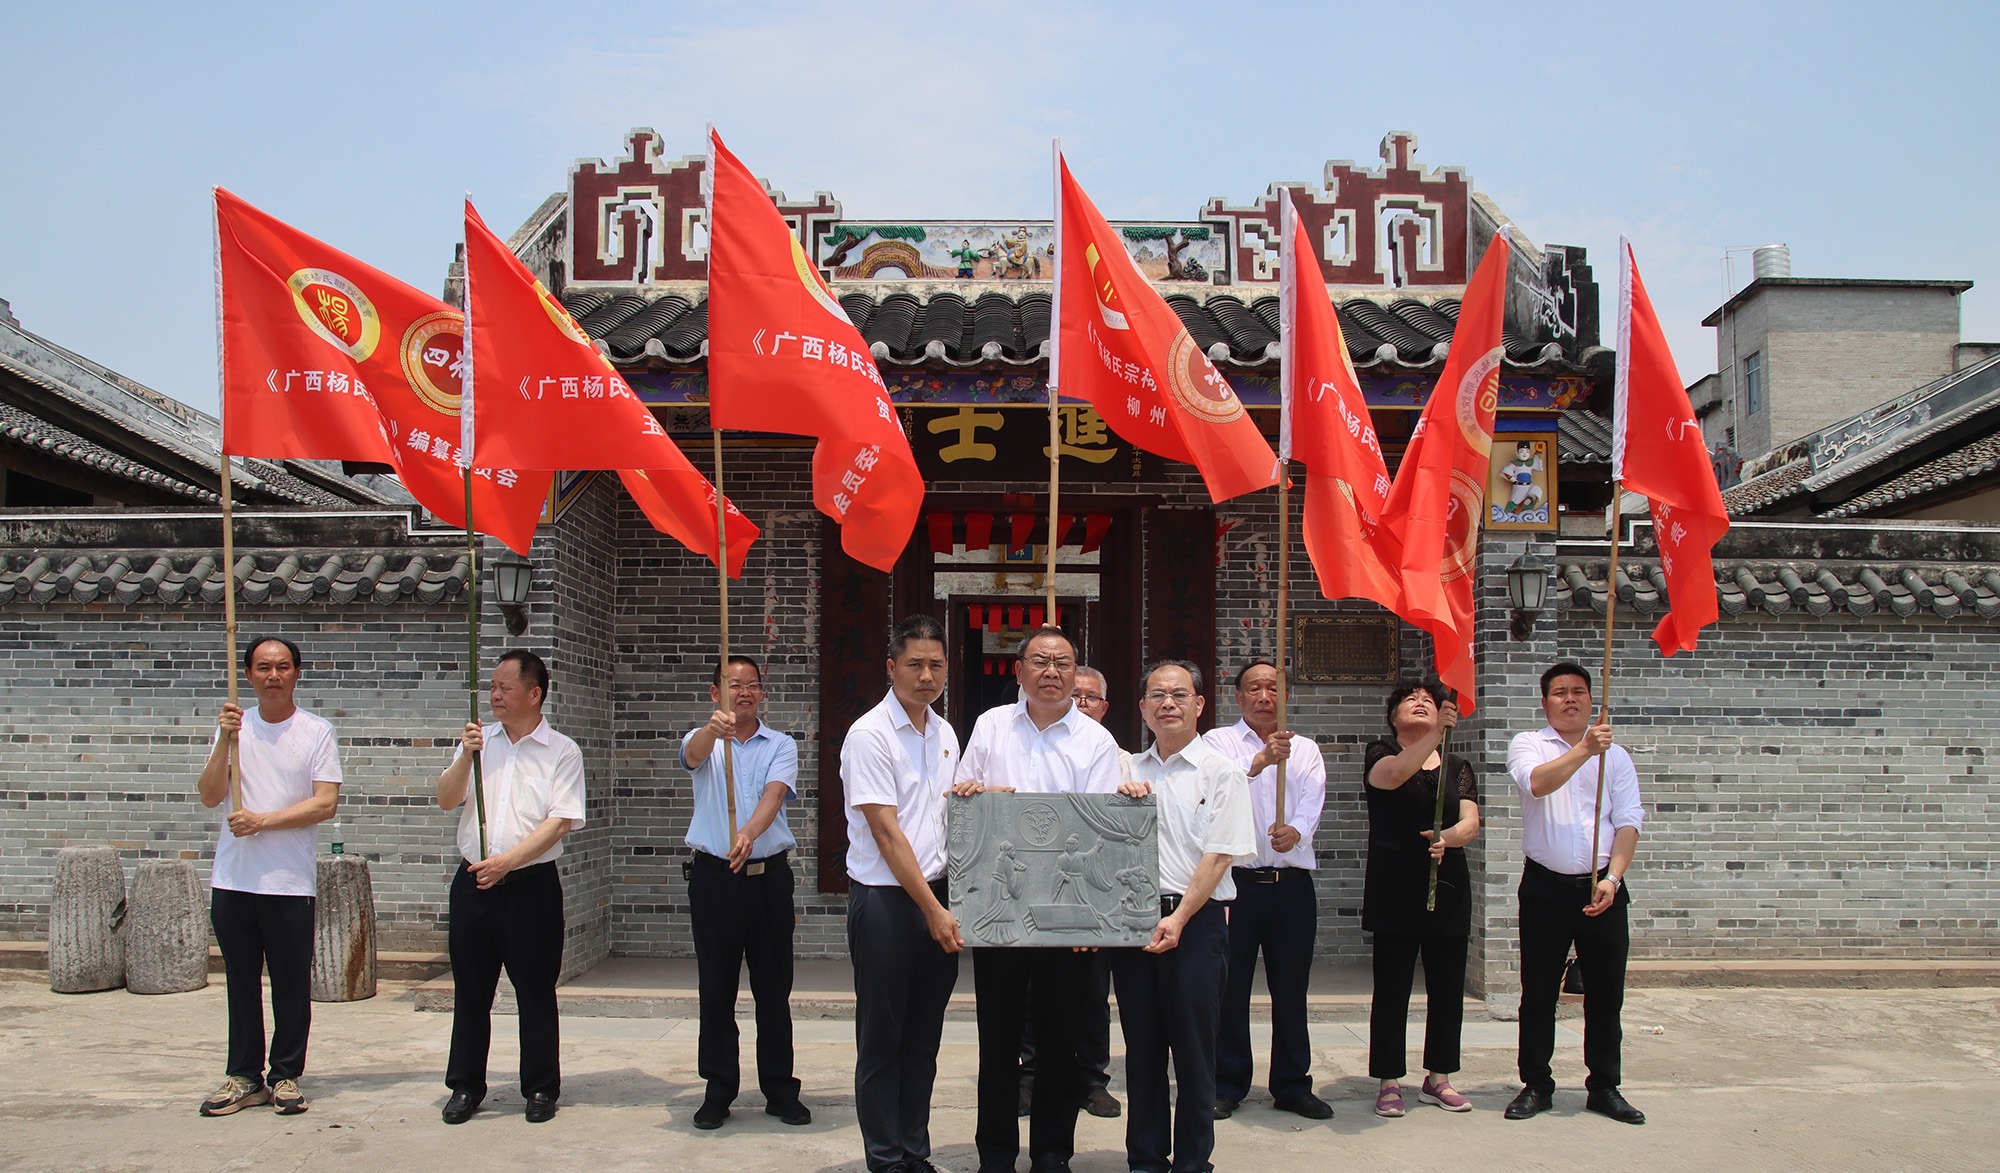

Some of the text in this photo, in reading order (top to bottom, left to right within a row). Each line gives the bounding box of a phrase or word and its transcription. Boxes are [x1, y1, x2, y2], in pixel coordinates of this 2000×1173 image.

[752, 329, 889, 397] 《广西杨氏宗
[266, 368, 378, 410] 《广西杨氏
[518, 375, 638, 401] 《广西杨氏
[1126, 395, 1167, 427] 柳州
